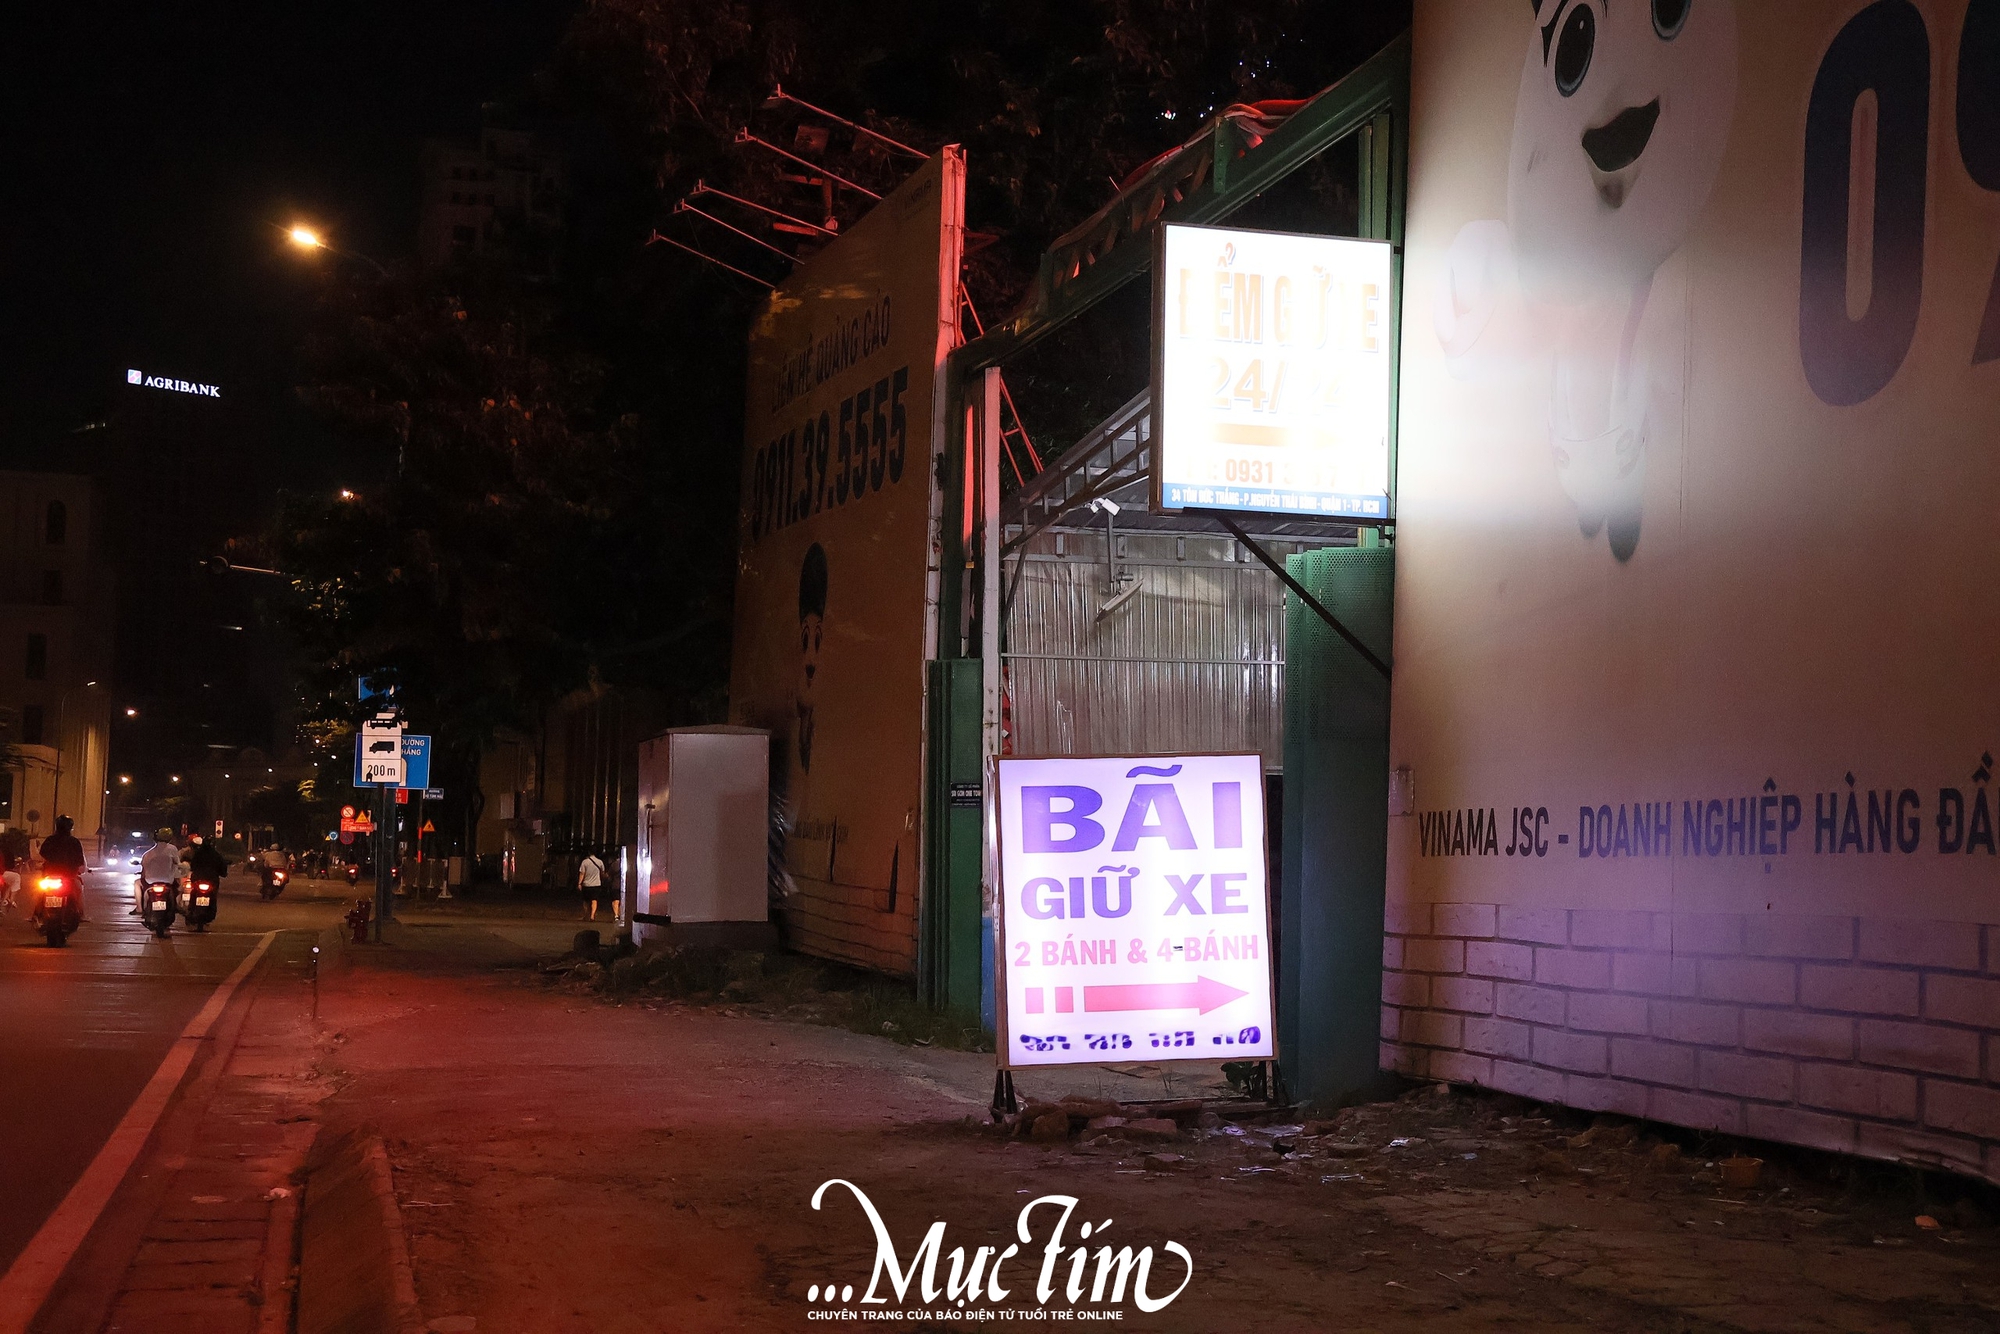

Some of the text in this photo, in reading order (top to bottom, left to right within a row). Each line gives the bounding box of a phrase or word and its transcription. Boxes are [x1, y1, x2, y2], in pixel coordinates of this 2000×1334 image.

[816, 314, 859, 385] QUẢNG
[863, 289, 891, 358] CÁO
[145, 376, 220, 397] AGRIBANK
[752, 365, 909, 543] 0911.39.5555
[1225, 458, 1274, 484] 0931
[367, 765, 396, 777] 200 m
[1020, 764, 1243, 853] BÃI
[1418, 806, 1499, 858] VINAMA
[1506, 806, 1549, 857] JSC
[1579, 801, 1672, 858] DOANH
[1682, 776, 1801, 874] NGHIỆP
[1815, 771, 1920, 856] HÀNG
[1936, 750, 2000, 856] ĐẦ
[1020, 865, 1249, 920] GIỮ XE
[1014, 941, 1031, 967] 2
[1042, 933, 1117, 966] BÁNH
[1127, 937, 1148, 964] &
